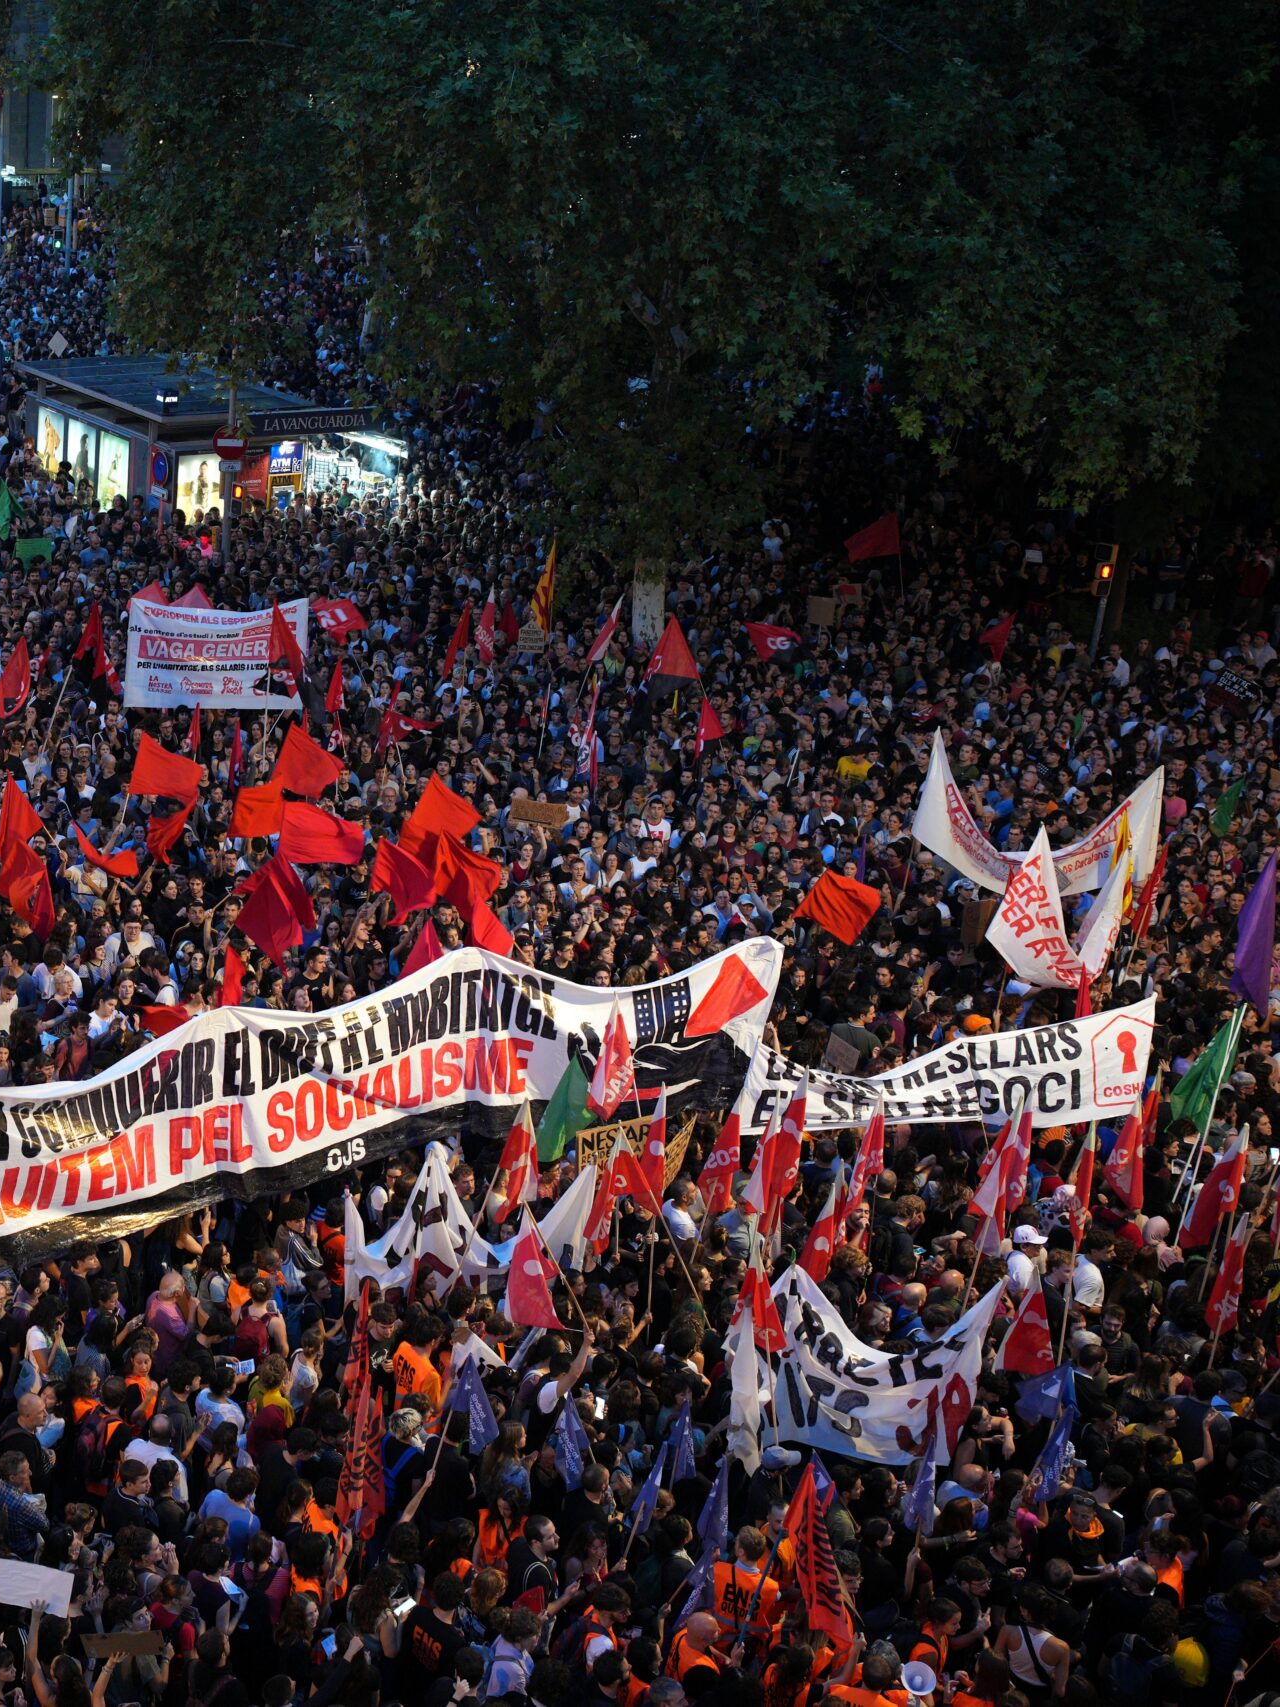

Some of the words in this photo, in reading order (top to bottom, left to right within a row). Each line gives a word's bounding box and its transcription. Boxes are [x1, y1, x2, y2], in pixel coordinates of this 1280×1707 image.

[264, 418, 280, 431] LA
[280, 413, 367, 431] VANGUARDIA
[270, 458, 291, 468] ATM
[145, 639, 197, 658] VAGA
[137, 661, 151, 669] PER
[223, 1027, 255, 1096] EL
[968, 1024, 1082, 1071] LLARS
[169, 1102, 253, 1175] PEL
[267, 1036, 537, 1152] SOCIALISME
[922, 1068, 1082, 1118] NEGOCI
[398, 1355, 416, 1385] ENS
[723, 1583, 761, 1614] ENS
